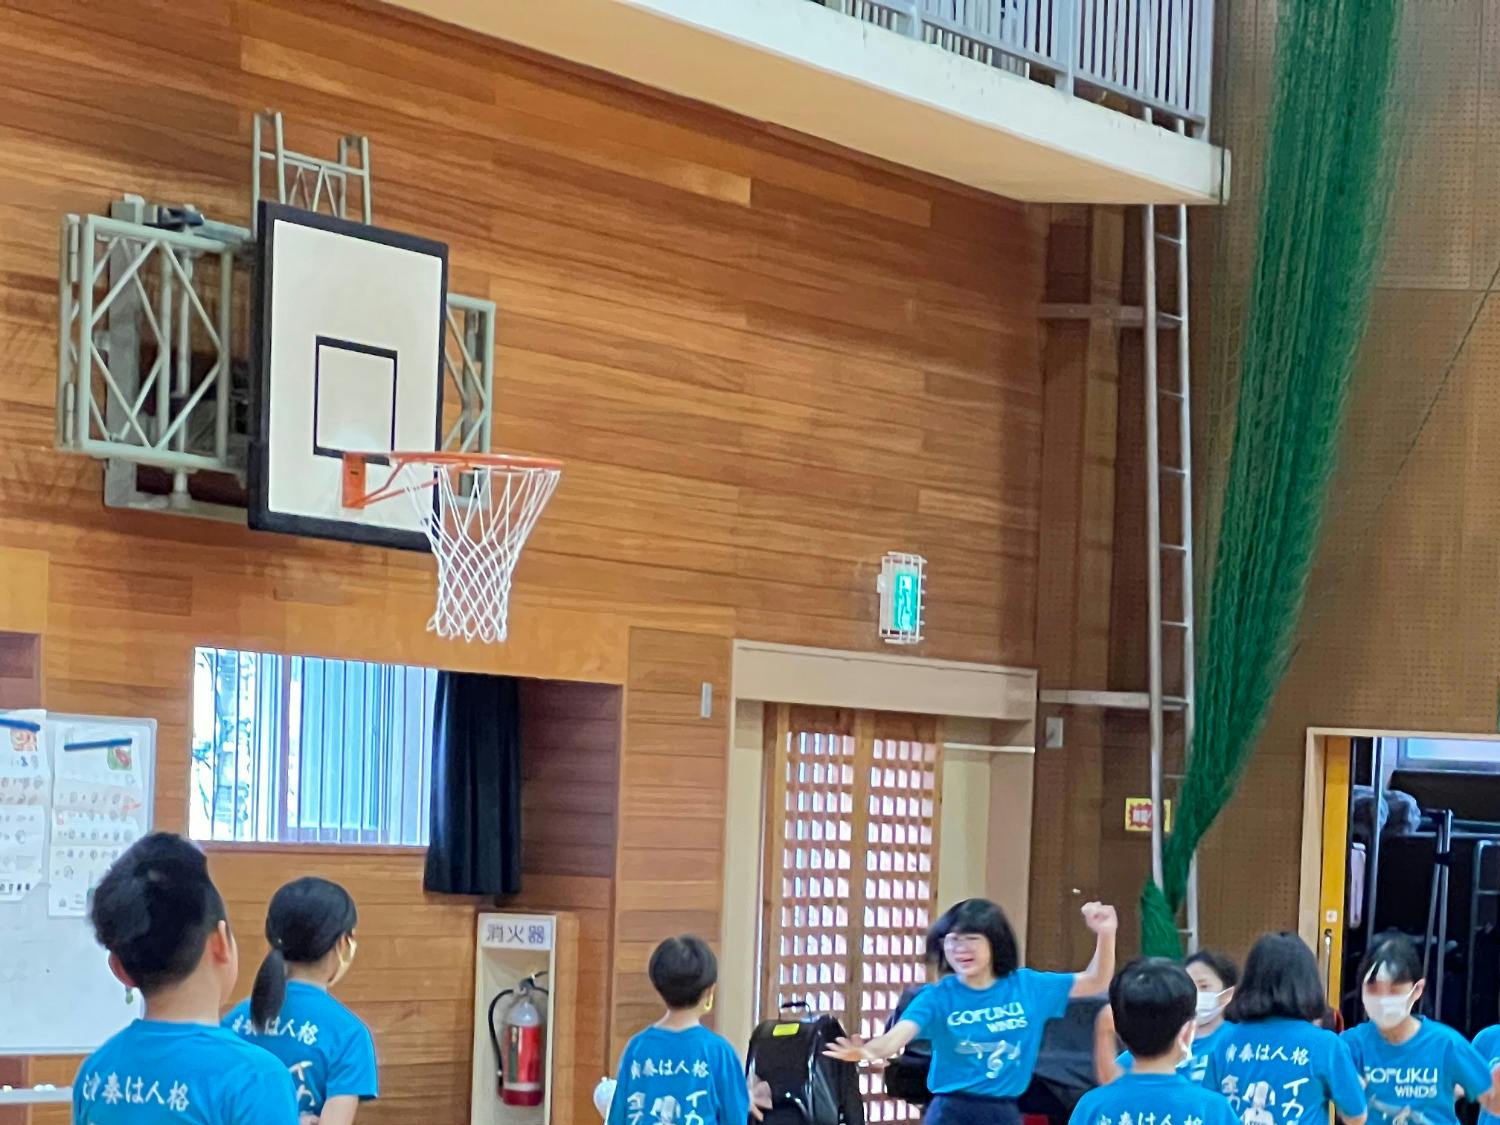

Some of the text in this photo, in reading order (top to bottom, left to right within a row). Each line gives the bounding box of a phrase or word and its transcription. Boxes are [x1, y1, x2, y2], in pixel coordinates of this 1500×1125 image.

[486, 923, 545, 944] 消火器
[947, 1002, 1025, 1026] GOFUKU
[1394, 1085, 1438, 1098] WINDS
